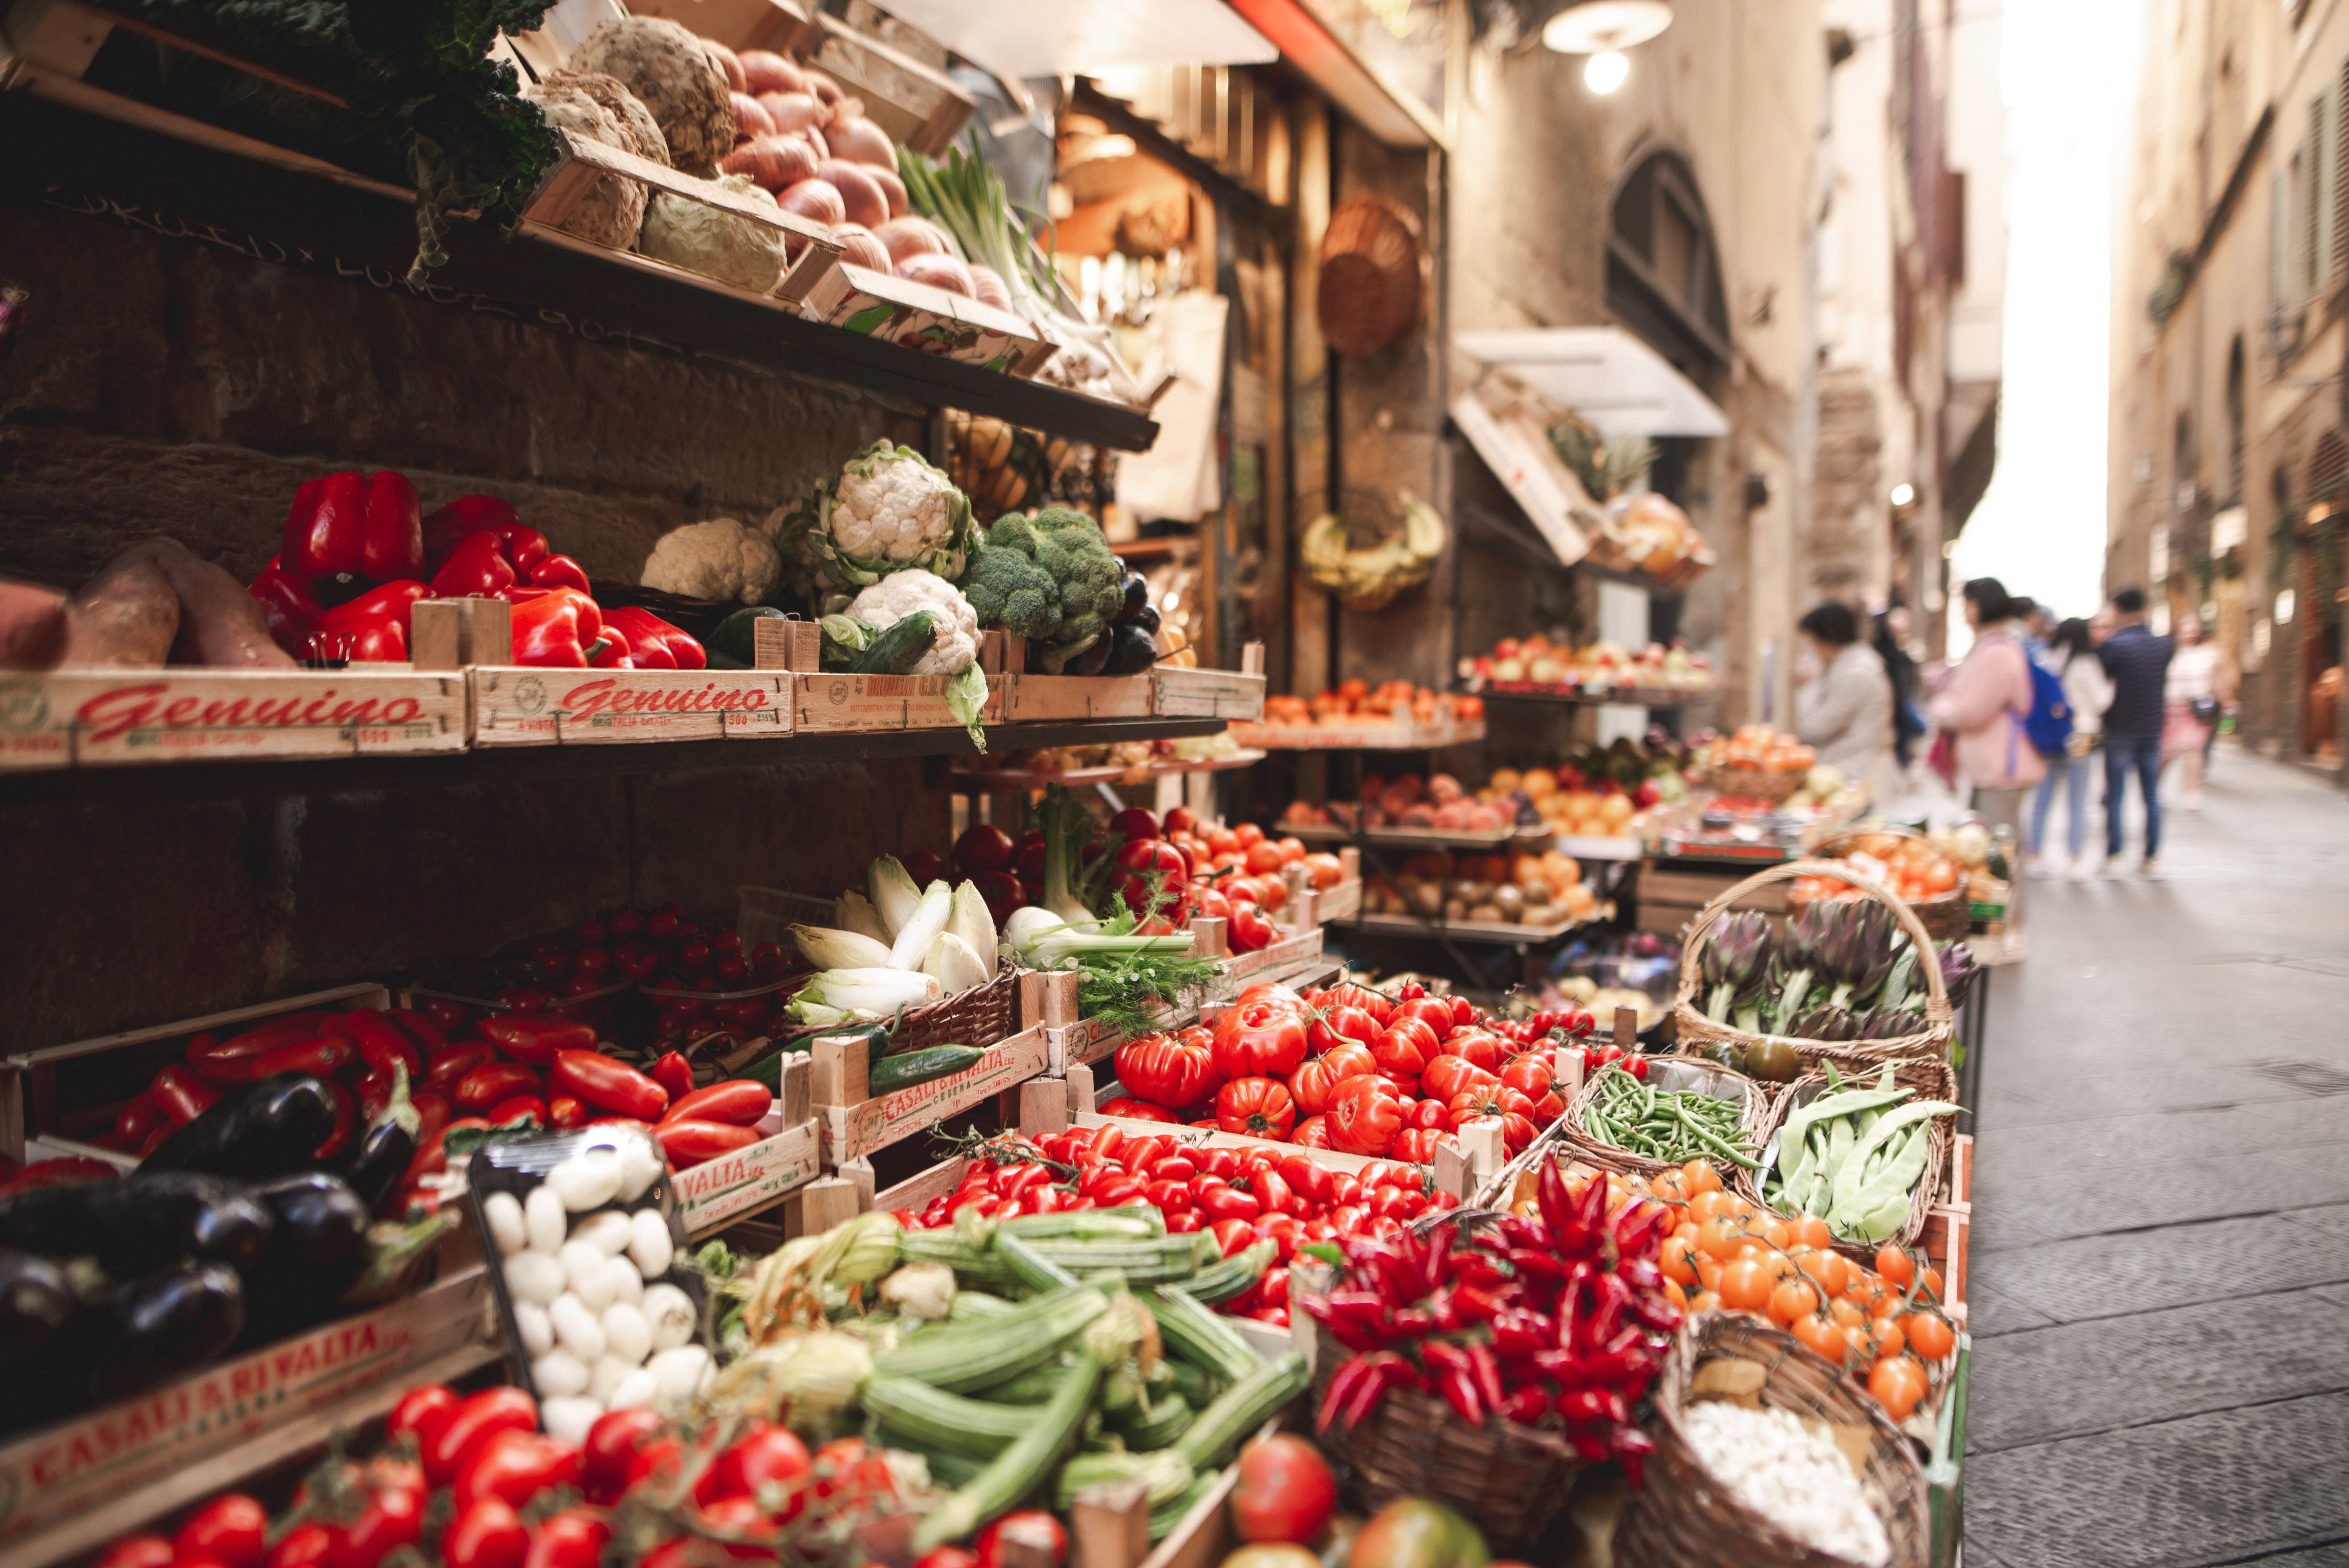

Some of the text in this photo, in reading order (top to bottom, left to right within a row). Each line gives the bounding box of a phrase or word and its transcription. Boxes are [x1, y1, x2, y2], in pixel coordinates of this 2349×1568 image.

[561, 679, 769, 725] Genuino
[866, 676, 916, 697] BRUNELLI
[78, 684, 426, 743] Genuino
[885, 1080, 936, 1121] CASALI
[940, 1076, 948, 1090] &
[673, 1158, 745, 1203] IVALTA
[31, 1390, 192, 1486] CASALI
[229, 1322, 377, 1399] RIVALTA
